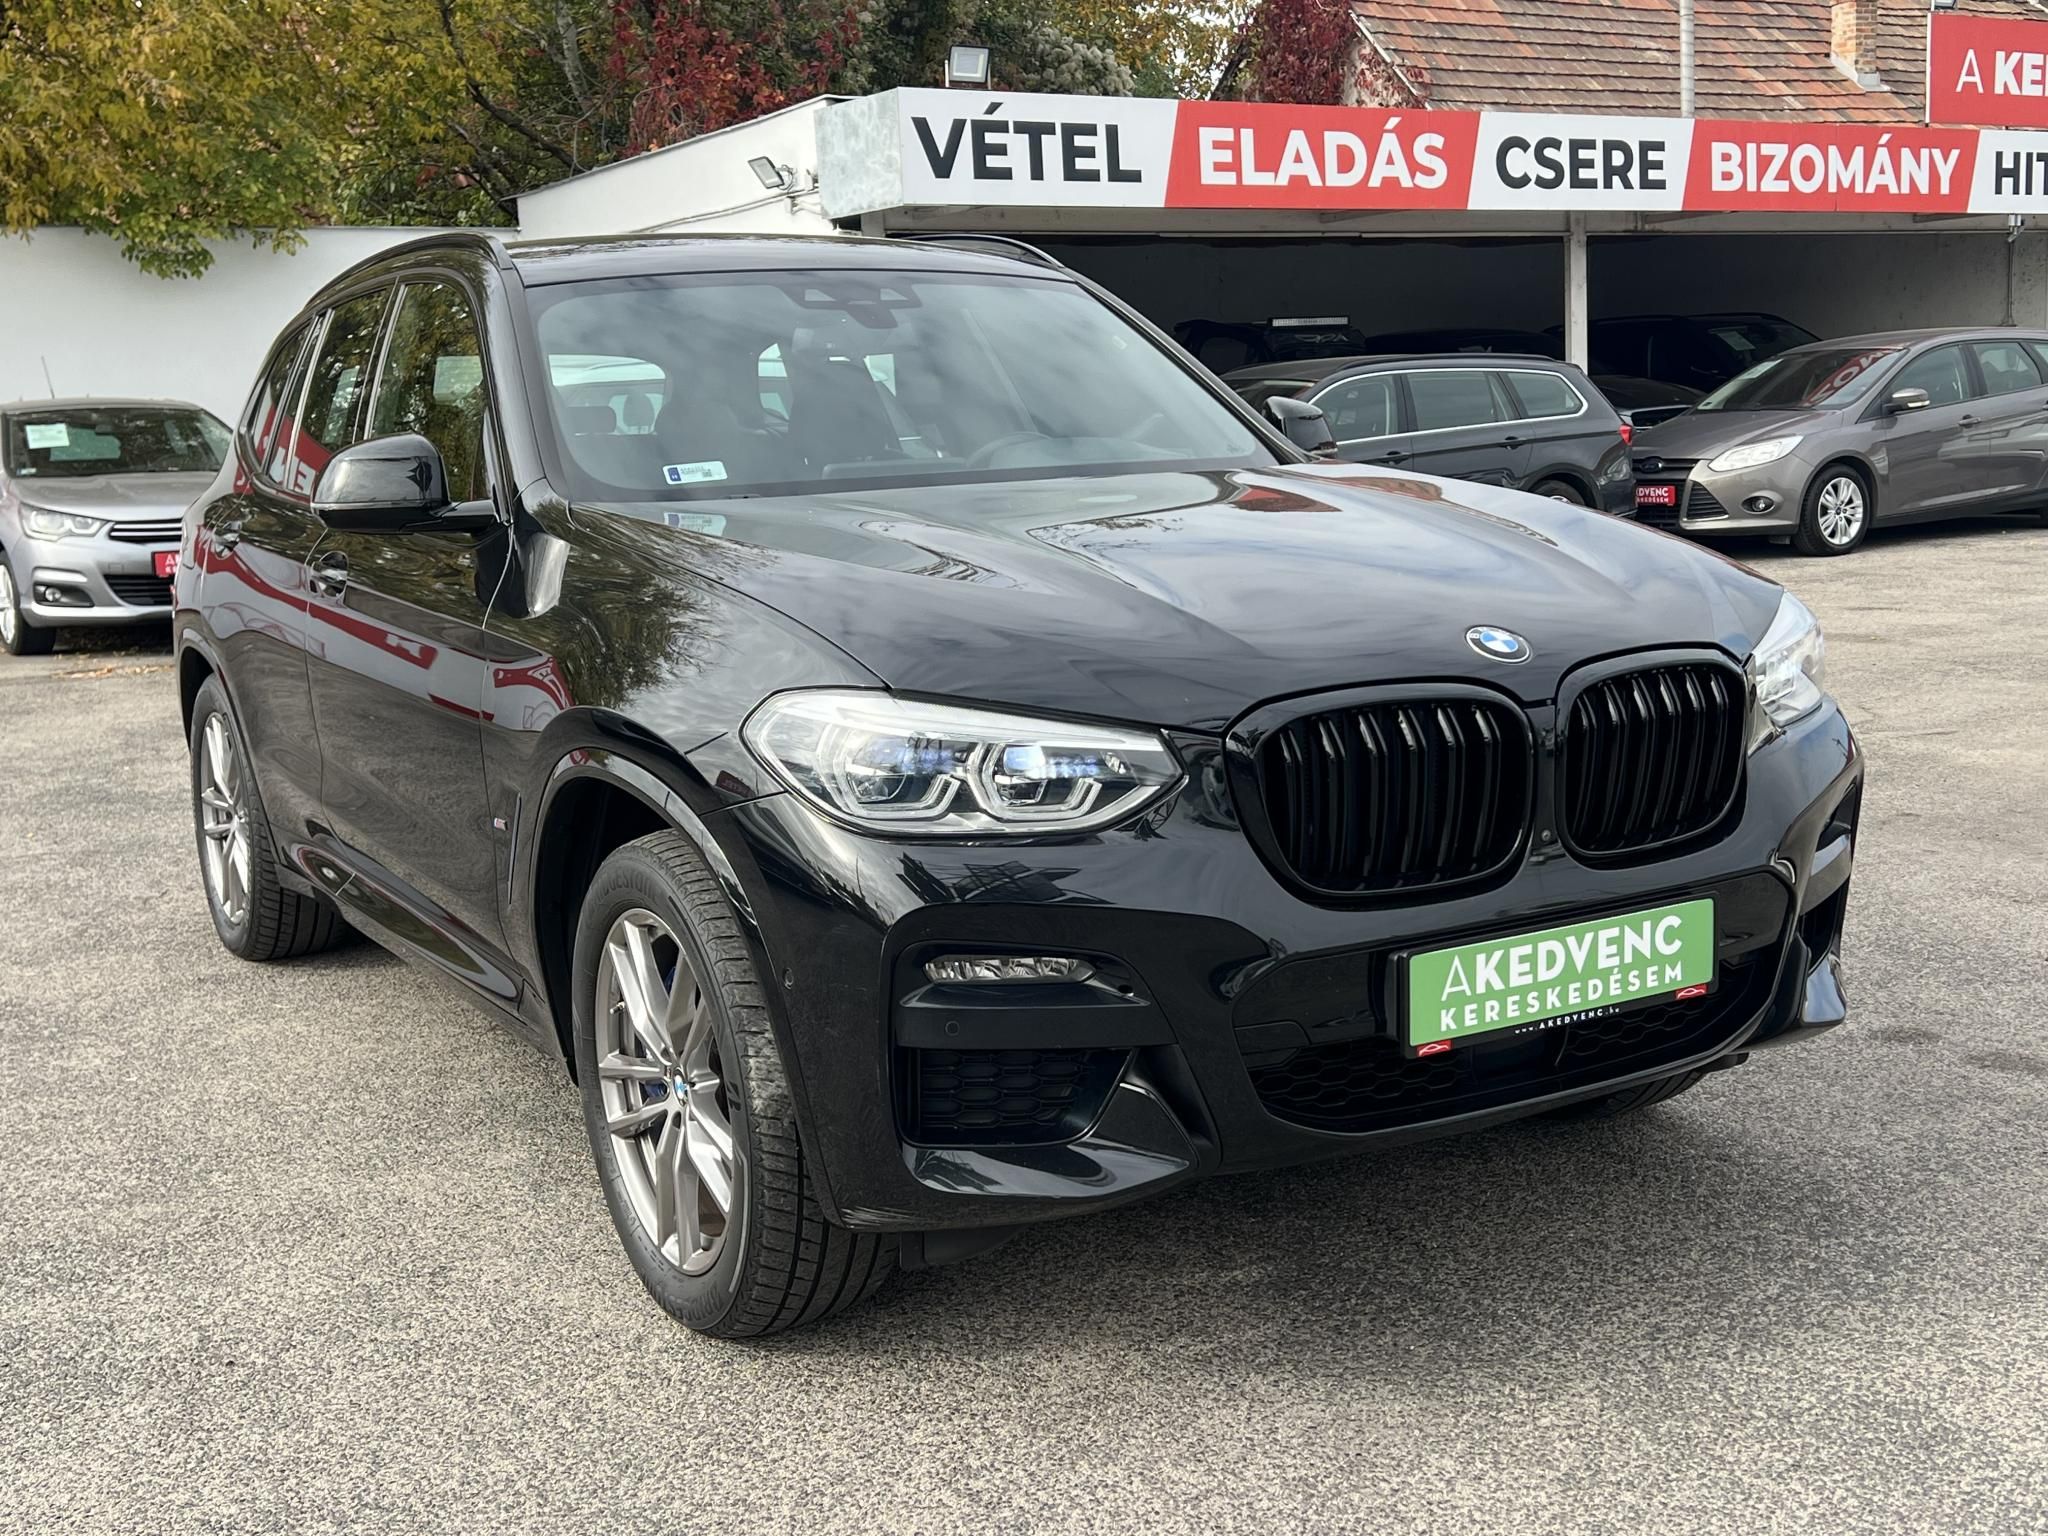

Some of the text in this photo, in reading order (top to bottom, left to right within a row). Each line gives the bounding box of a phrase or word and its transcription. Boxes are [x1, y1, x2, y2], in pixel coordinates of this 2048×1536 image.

[1956, 49, 2048, 96] A KE
[912, 102, 1141, 182] VÉTEL
[1199, 117, 1447, 189] ELADÁS
[1496, 136, 1666, 190] CSERE
[1712, 134, 1960, 195] BIZOMÁNY
[1636, 487, 1668, 497] DVENC
[1440, 961, 1682, 1032] KERESKEDÉSEM
